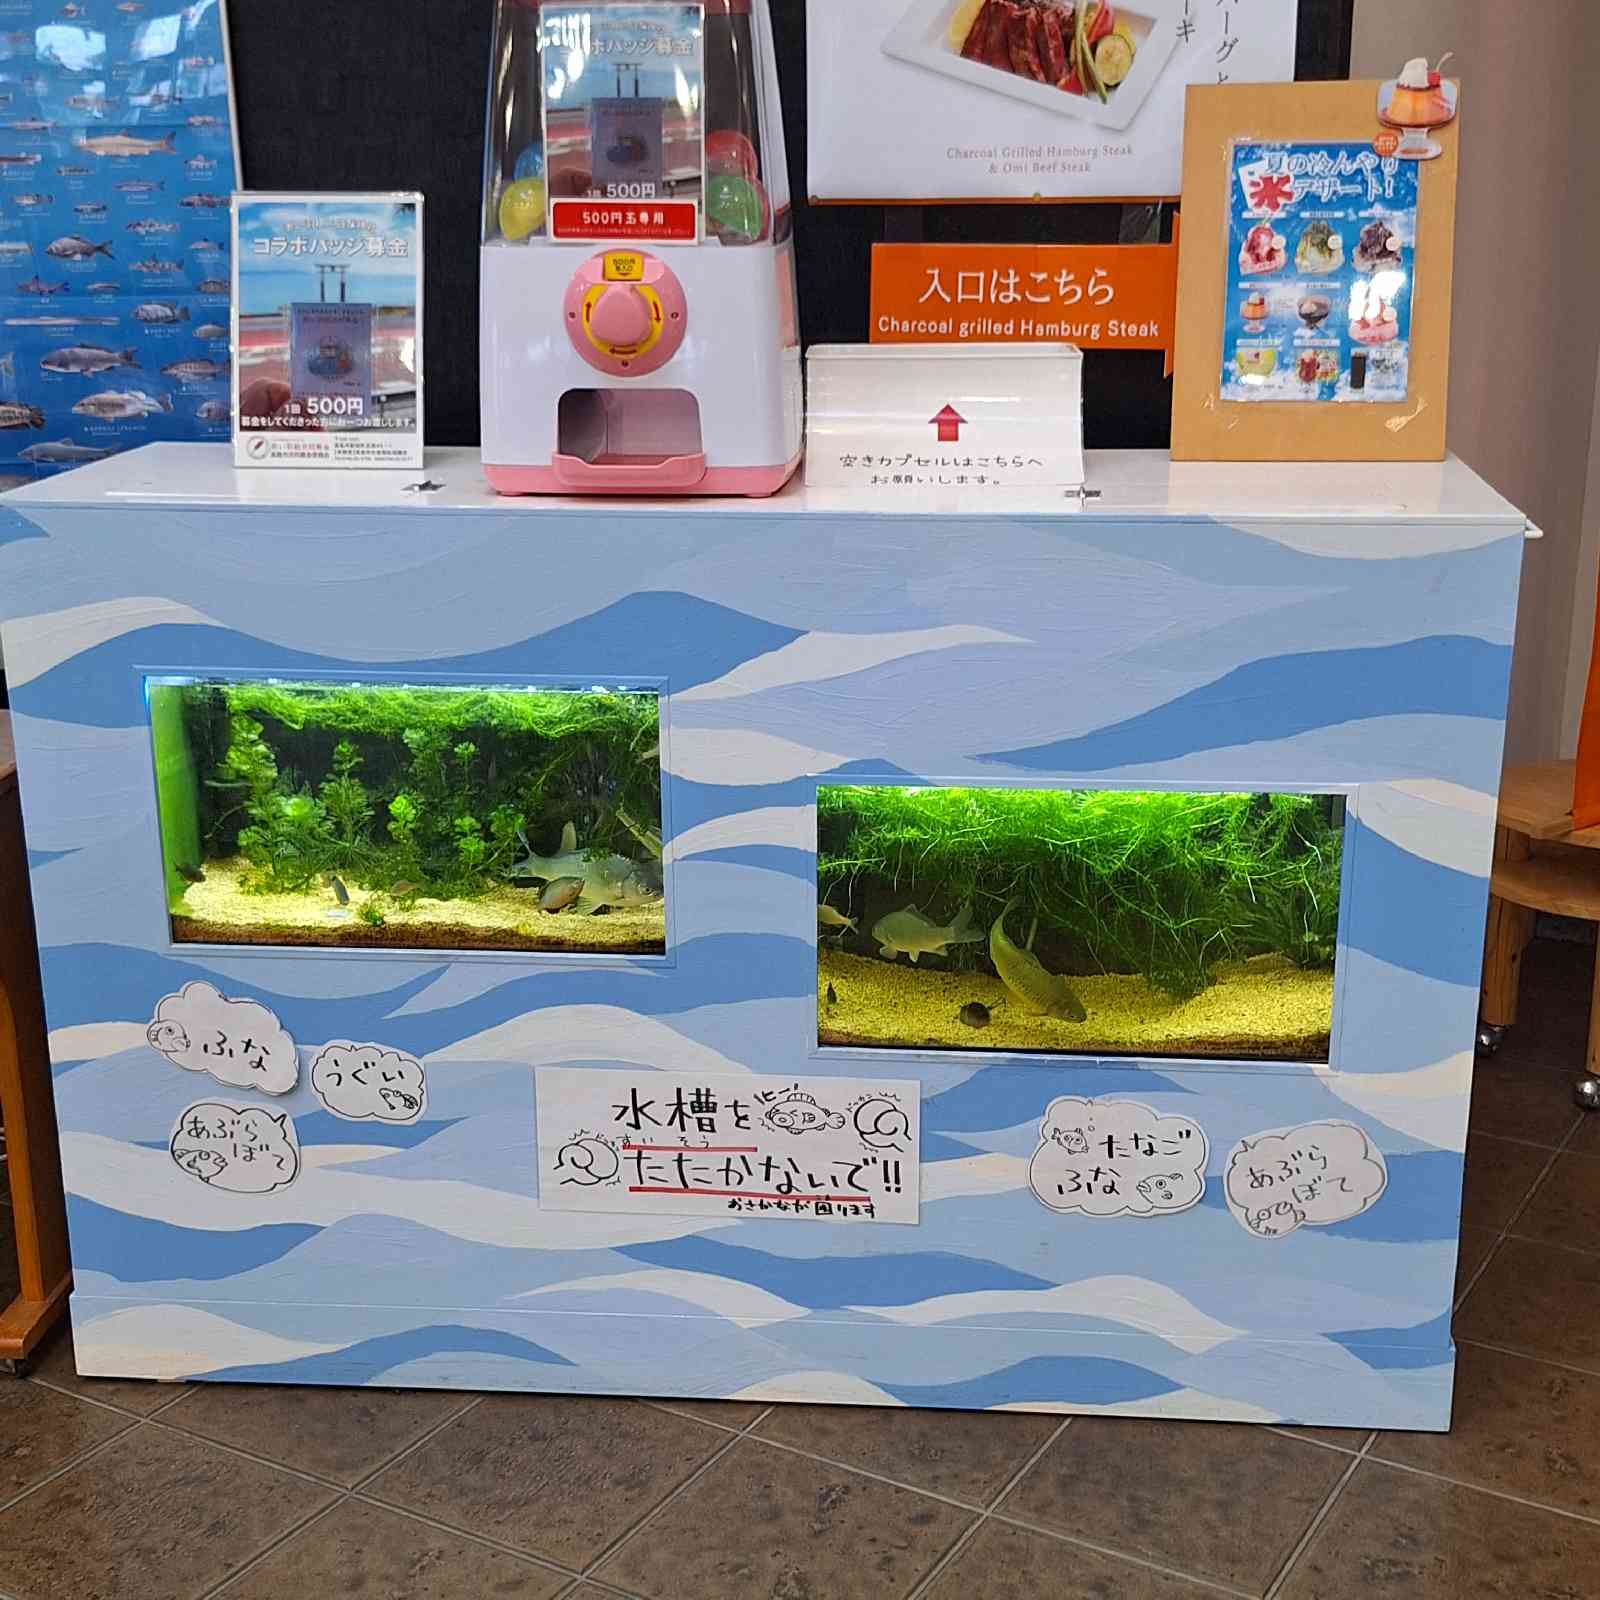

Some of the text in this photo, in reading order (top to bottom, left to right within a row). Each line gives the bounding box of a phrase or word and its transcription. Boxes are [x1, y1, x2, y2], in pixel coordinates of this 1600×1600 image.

[946, 143, 1133, 159] Charcoal Grilled Hamburg Steak
[988, 161, 1091, 174] & Omi Beef Steak
[607, 183, 656, 199] 500円
[918, 267, 1115, 305] 入口はこちら
[878, 316, 1160, 340] Charcoal grilled Hamburg Steak
[307, 397, 364, 415] 500円
[203, 1030, 270, 1072] ふな
[326, 1059, 405, 1087] うぐい
[611, 1087, 752, 1133] 水槽を
[187, 1115, 258, 1142] あぶら
[1099, 1129, 1192, 1159] たなご
[623, 1150, 902, 1195] たたかないで!!
[1246, 1144, 1328, 1189] あぶら
[1057, 1166, 1122, 1196] ふな
[727, 1197, 876, 1219] おさかなが困ります
